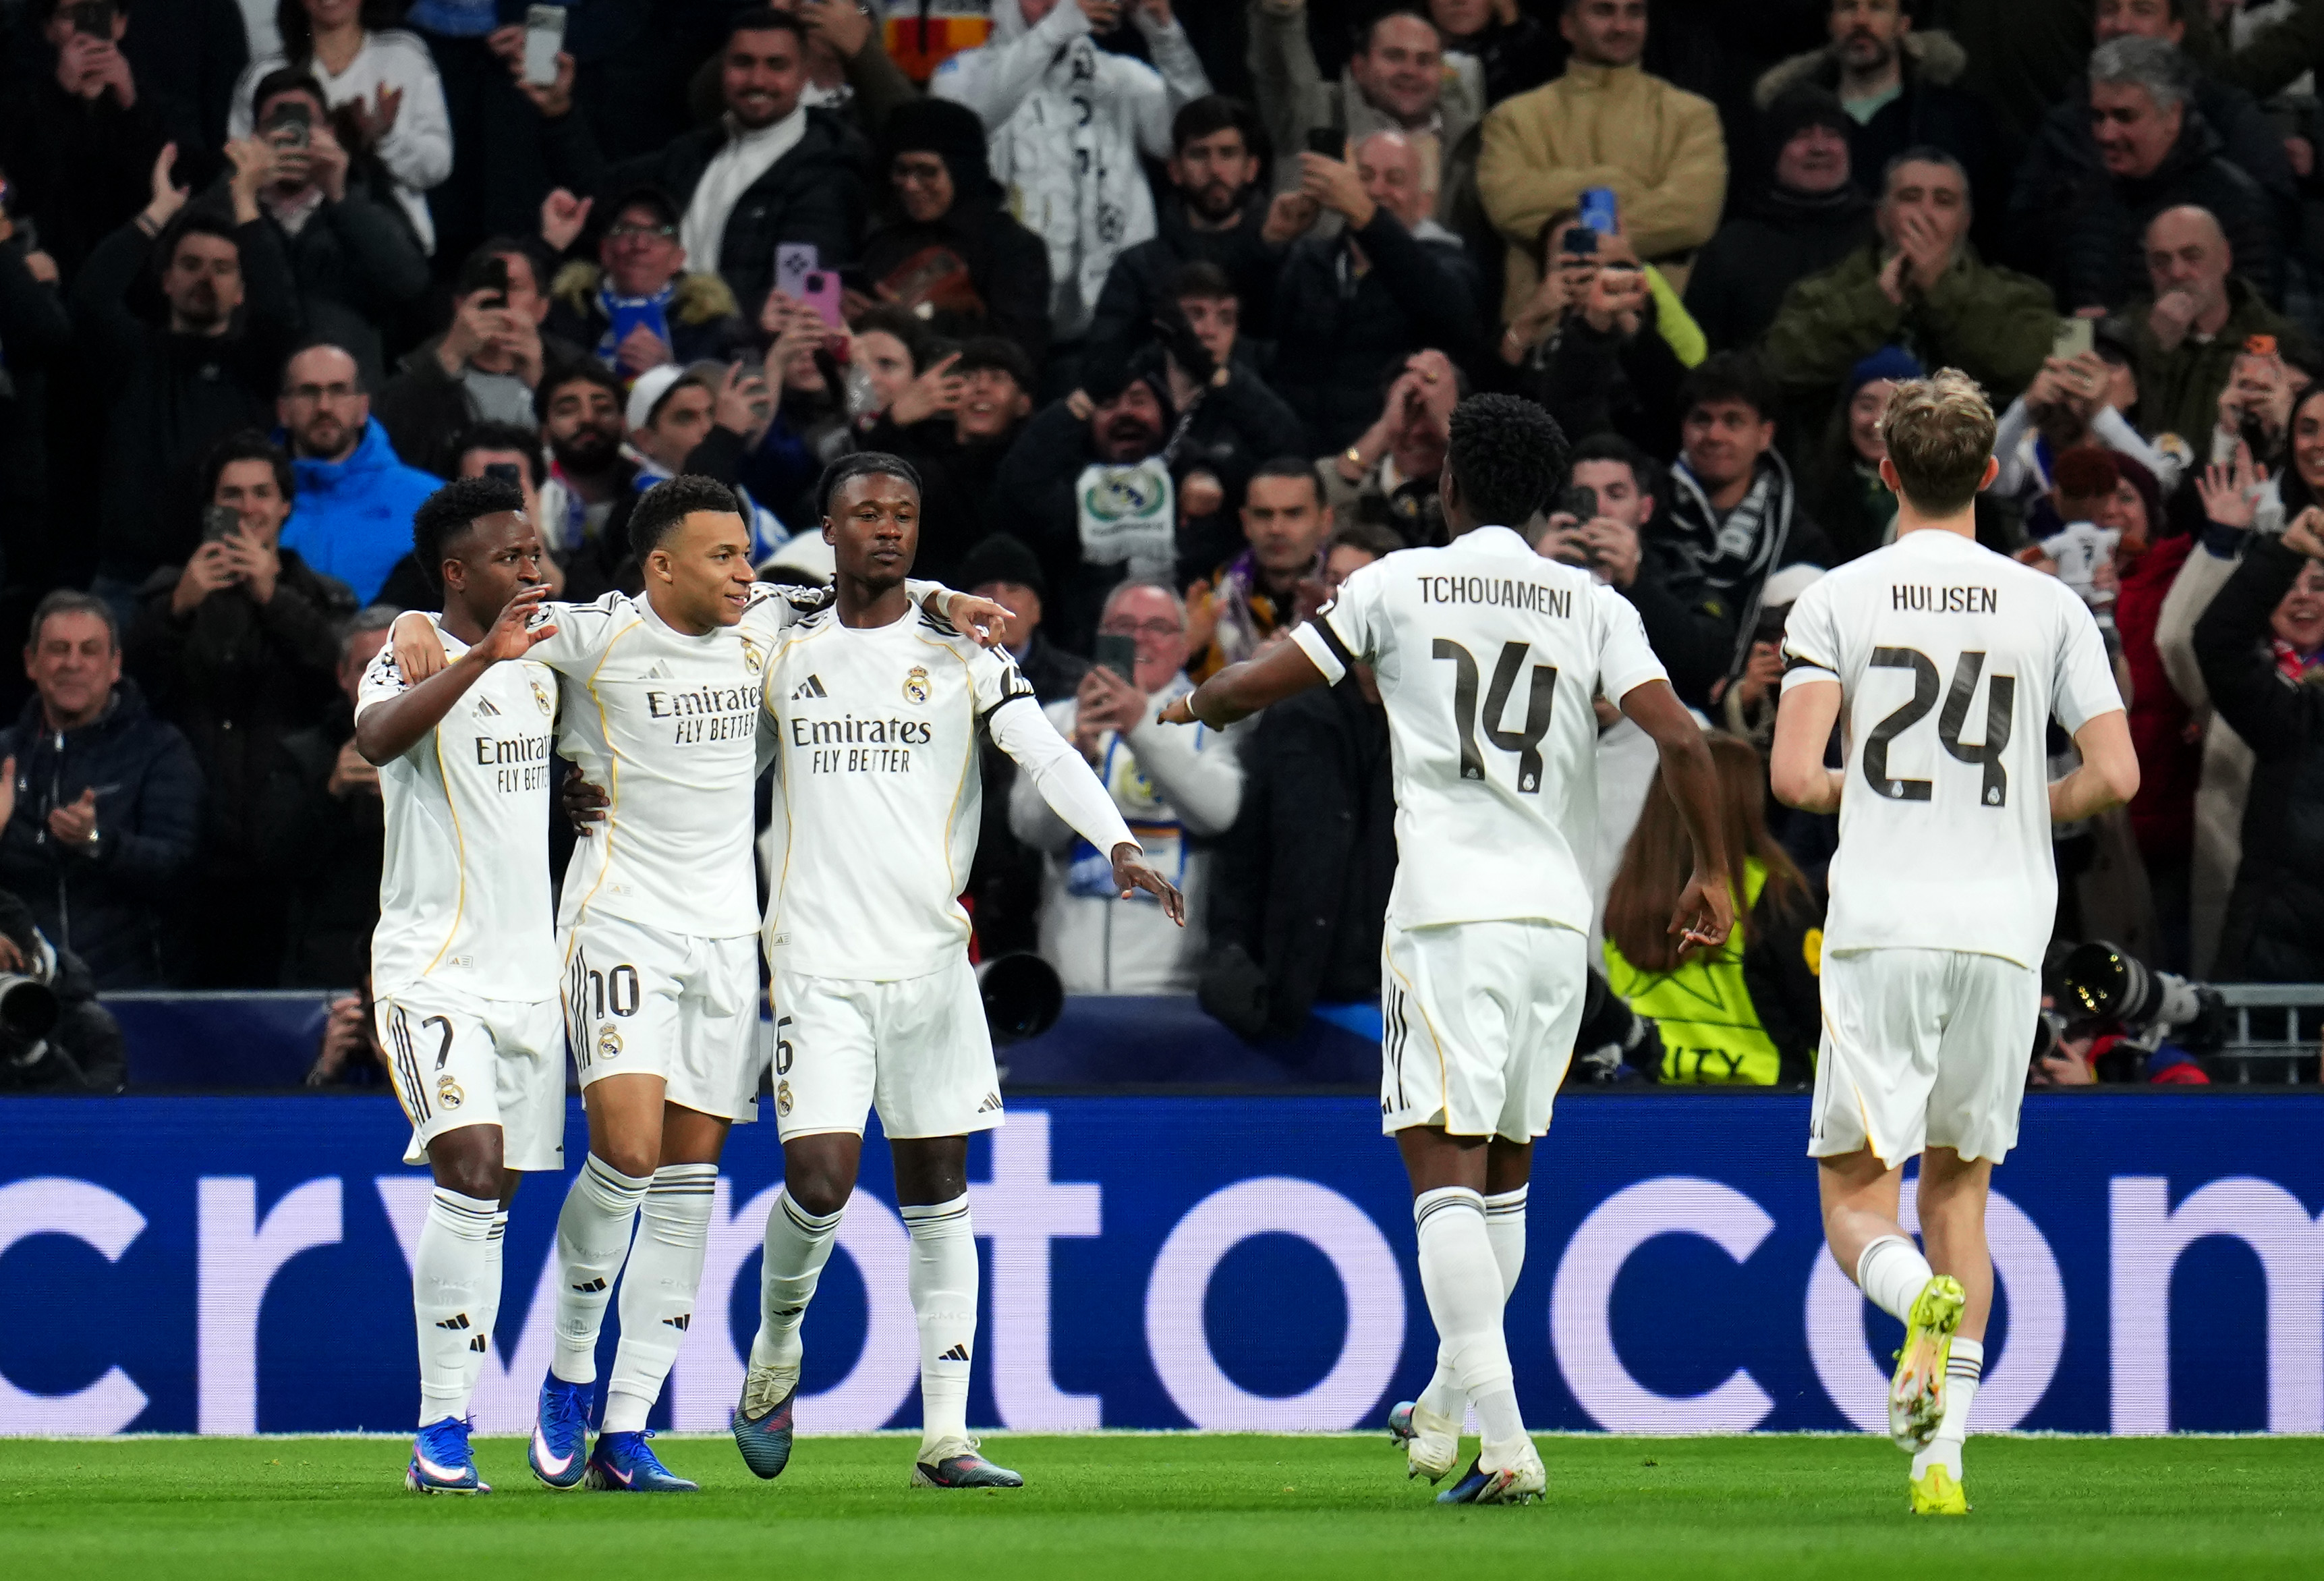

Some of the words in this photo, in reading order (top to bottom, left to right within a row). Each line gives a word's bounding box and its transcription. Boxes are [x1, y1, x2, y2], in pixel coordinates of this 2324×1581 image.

[1418, 576, 1572, 619] TCHOUAMENI
[1892, 584, 1997, 615] HUIJSEN
[675, 719, 704, 744] FLY
[710, 712, 755, 741] BETTER
[790, 713, 932, 747] Emirates
[1432, 638, 1558, 794] 14
[1863, 646, 2015, 807] 24
[475, 732, 551, 765] Emirat
[813, 750, 841, 774] FLY
[848, 749, 909, 773] BETTER
[498, 769, 519, 794] FLY
[590, 964, 640, 1020] 10
[422, 1015, 454, 1072] 7
[776, 1016, 793, 1076] 6
[0, 1110, 2324, 1435] cryptocom
